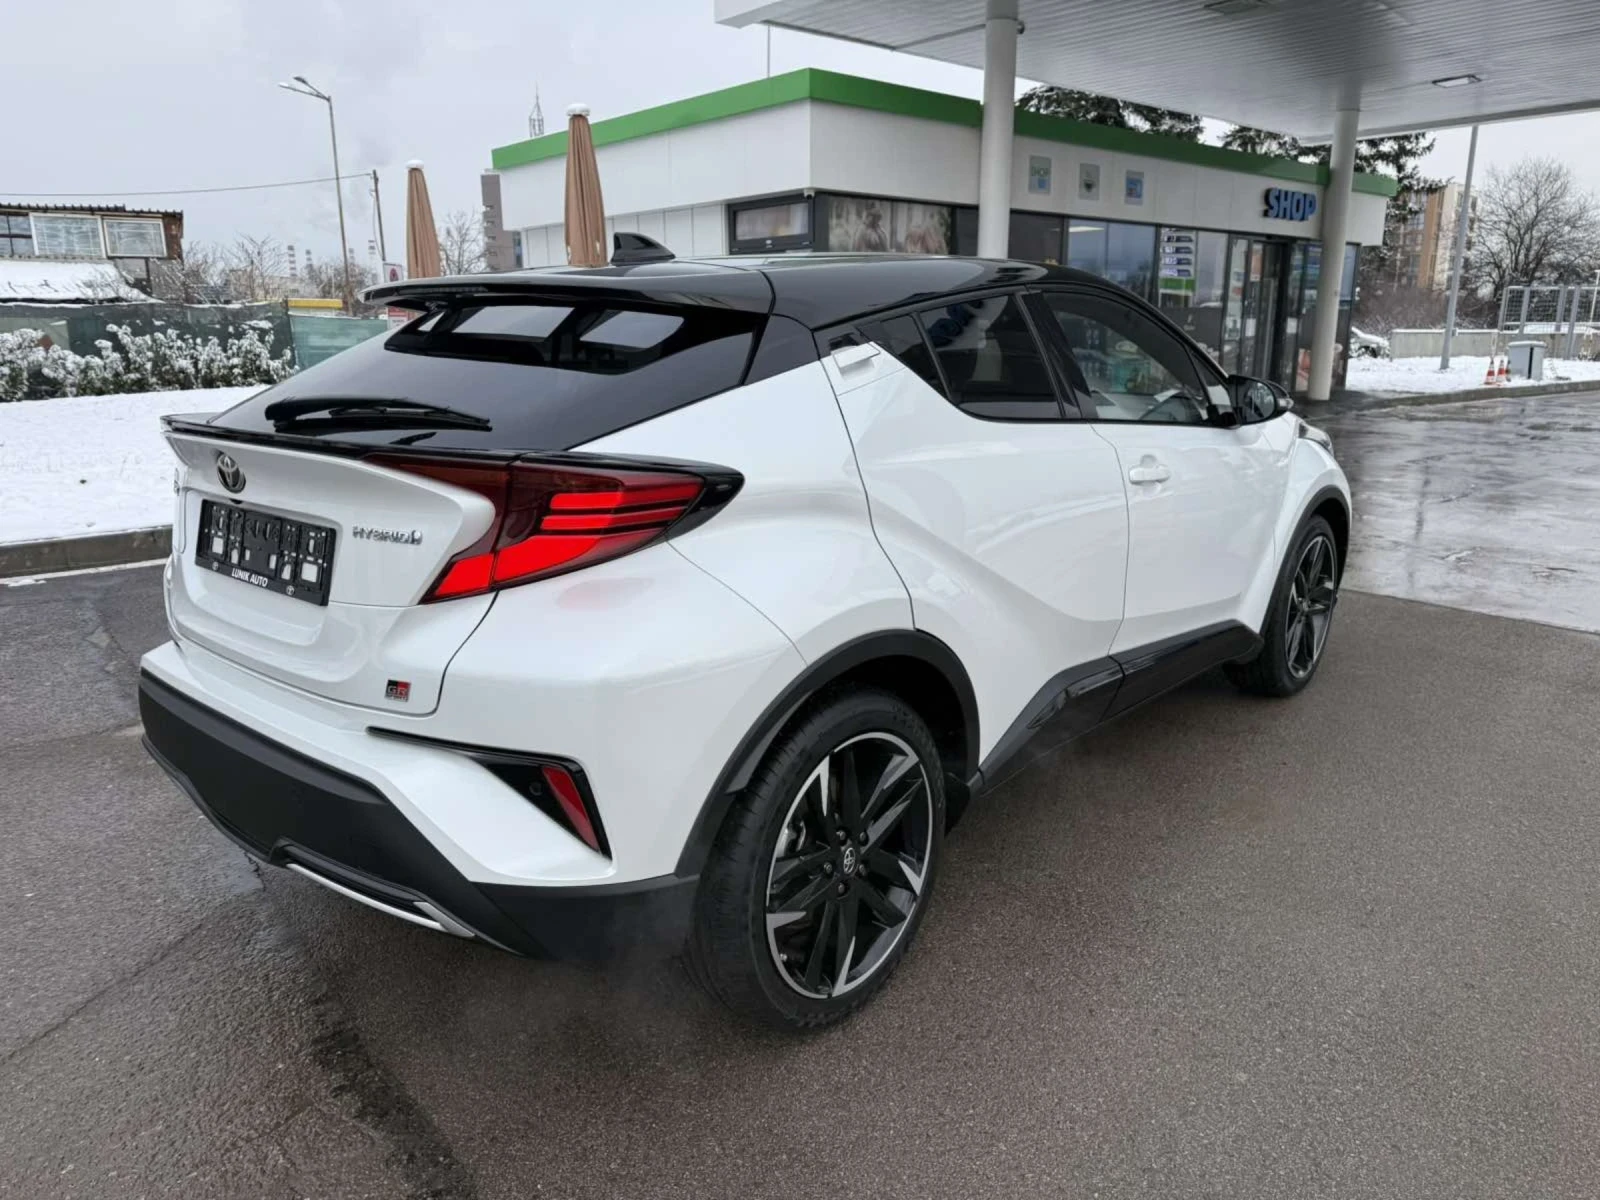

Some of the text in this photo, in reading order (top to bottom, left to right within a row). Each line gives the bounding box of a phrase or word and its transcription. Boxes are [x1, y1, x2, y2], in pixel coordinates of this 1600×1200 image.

[1264, 187, 1316, 221] SHOP
[231, 567, 269, 588] LUNIK AUTO
